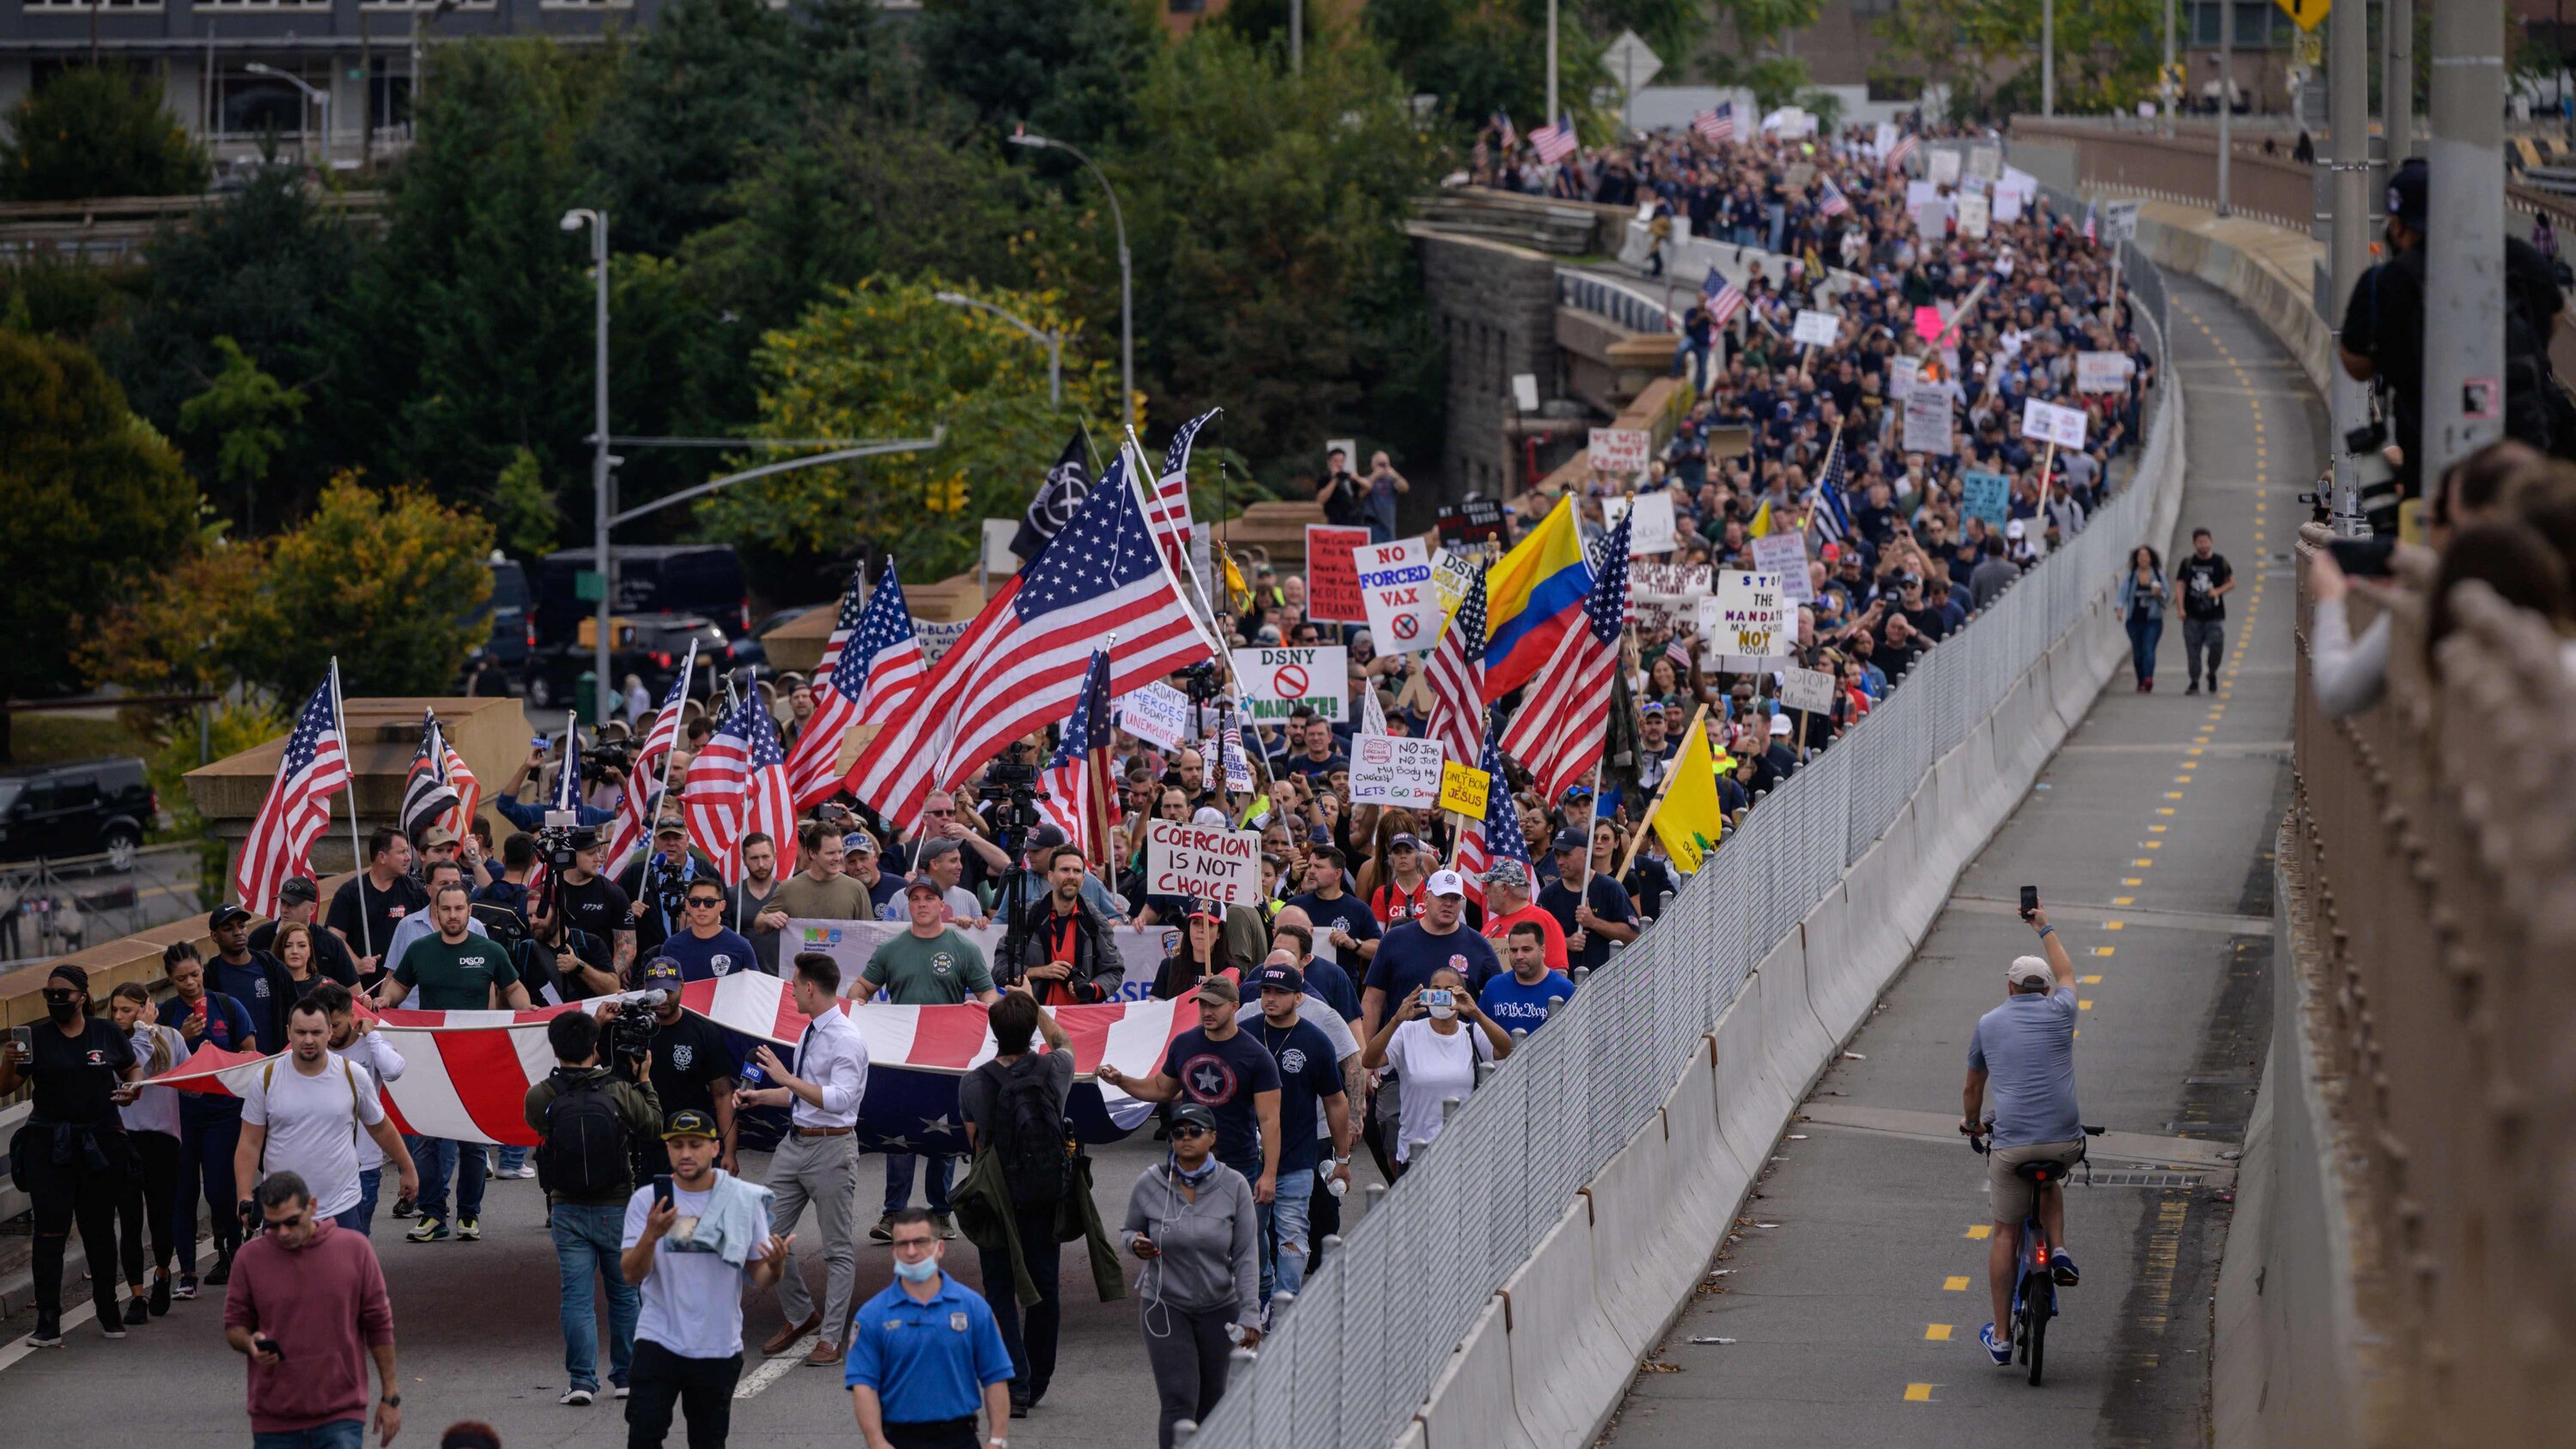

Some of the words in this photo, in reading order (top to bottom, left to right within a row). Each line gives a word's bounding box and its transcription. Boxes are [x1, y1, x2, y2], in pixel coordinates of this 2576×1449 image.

[1376, 546, 1405, 564] NO
[1443, 554, 1478, 581] DSN
[1359, 565, 1431, 590] FORCED
[1381, 588, 1419, 607] VAX
[1753, 593, 1773, 607] THE
[1313, 602, 1362, 617] TYRANNY
[1725, 610, 1783, 622] MANDATE
[1730, 623, 1747, 632] MY
[1739, 631, 1771, 647] NOT
[1261, 649, 1315, 665] DSNY
[1739, 646, 1771, 656] YOURS
[1790, 669, 1829, 688] STOP
[1143, 680, 1187, 709] ERDAY'S
[1133, 689, 1184, 723] HEROES
[1139, 703, 1174, 728] TODAY'S
[1420, 744, 1440, 756] JAB
[1225, 770, 1248, 780] OURS
[1396, 766, 1421, 781] Body
[1445, 771, 1467, 785] ONLY
[1468, 776, 1488, 791] BOW
[1355, 785, 1386, 797] LET'S
[1391, 786, 1410, 797] GO
[1448, 787, 1482, 807] JESUS
[1153, 824, 1250, 858] COERCION
[1170, 850, 1189, 870] IS
[1196, 856, 1242, 877] NOT
[1158, 872, 1237, 901] CHOICE
[804, 927, 842, 943] NYC
[1265, 970, 1286, 979] FDNY
[1493, 1001, 1506, 1016] We
[1522, 1003, 1549, 1021] Peop
[745, 1066, 760, 1077] NTD
